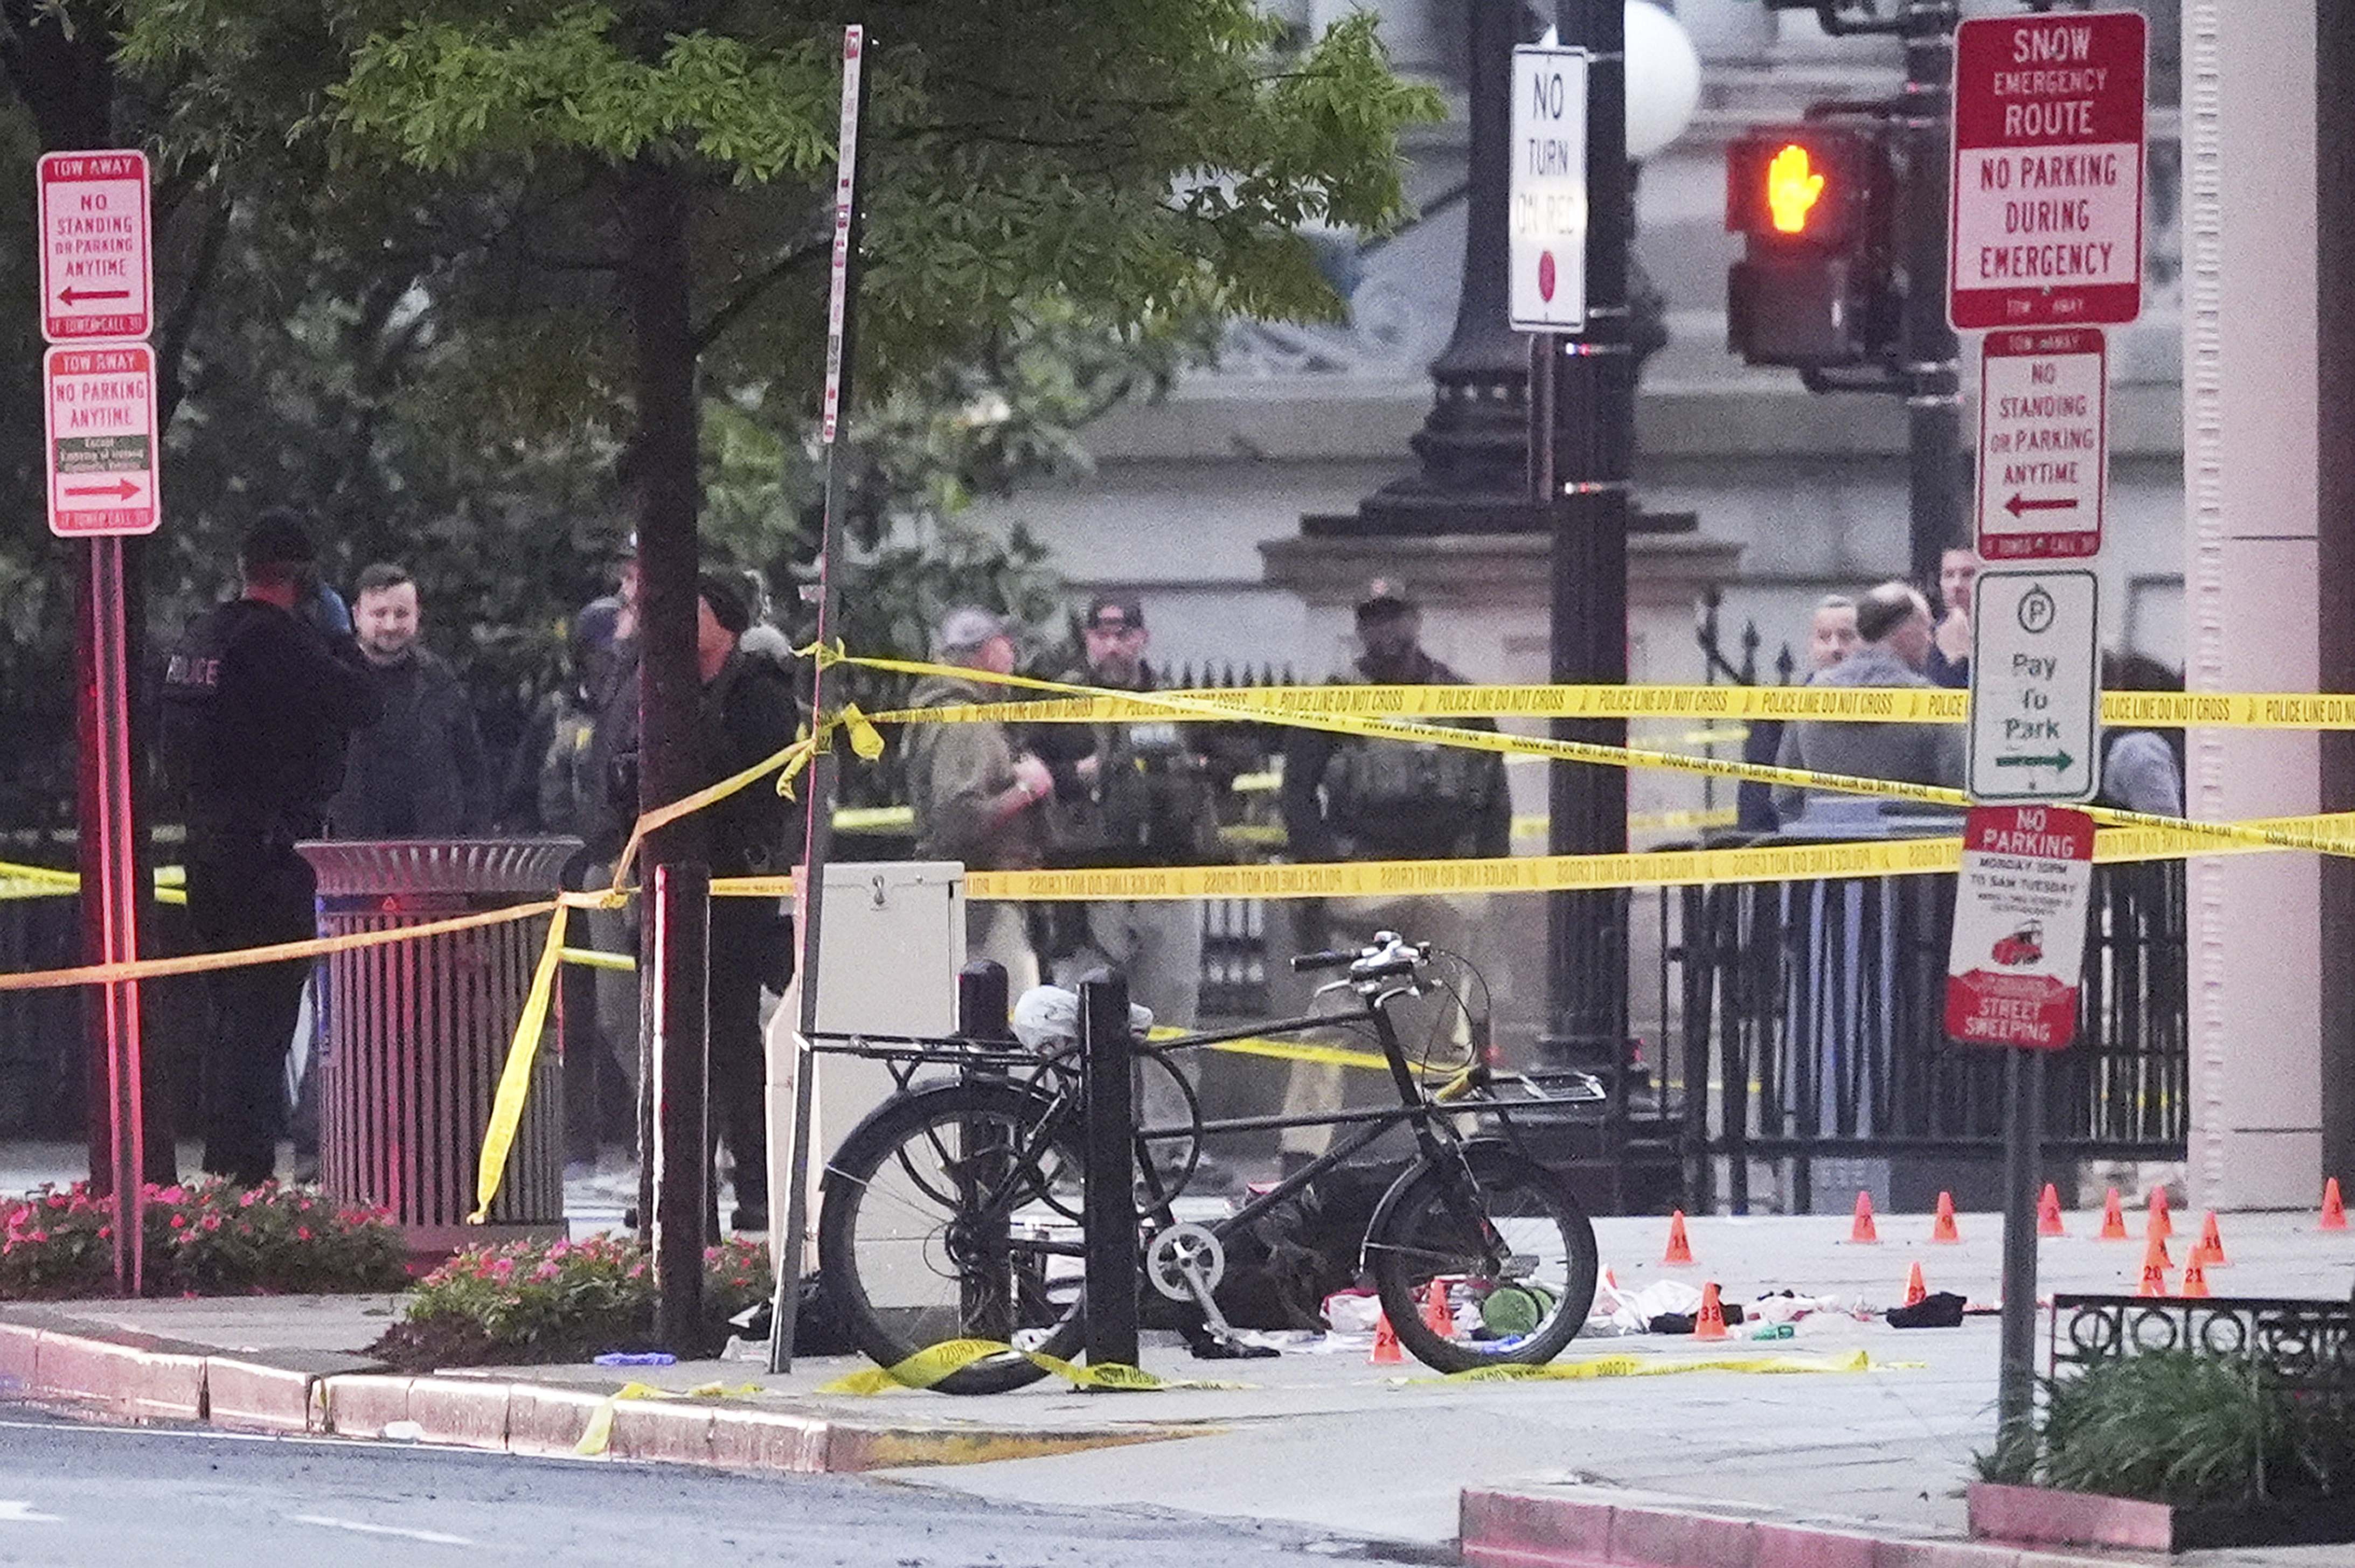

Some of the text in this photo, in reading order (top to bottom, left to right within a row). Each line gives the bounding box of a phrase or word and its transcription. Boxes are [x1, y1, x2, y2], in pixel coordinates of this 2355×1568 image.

[2013, 27, 2092, 63] SNOW
[1994, 68, 2108, 95] EMERGENCY
[1534, 73, 1562, 120] NO
[2005, 101, 2095, 137] ROUTE
[1529, 138, 1568, 175] TURN
[54, 160, 131, 176] TOW AWAY
[1981, 154, 2117, 190] NO PARKING
[81, 194, 107, 211] NO
[1517, 194, 1537, 234] ON
[2005, 199, 2089, 233] DURING
[58, 217, 133, 235] STANDING
[55, 238, 133, 254] OR PARKING
[66, 259, 126, 277] ANYTIME
[1981, 243, 2113, 278] EMERGENCY
[63, 354, 135, 372] TOW AWAY
[2031, 363, 2055, 384] NO
[57, 381, 144, 402] NO PARKING
[2000, 395, 2086, 417] STANDING
[71, 408, 132, 428] ANYTIME
[2016, 429, 2095, 451] PARKING
[2004, 462, 2078, 484] ANYTIME
[2030, 599, 2045, 623] P
[2012, 654, 2057, 680] Pay
[1281, 690, 1404, 711] POLICE LINE DO NOT CROSS
[1437, 689, 1565, 710] POLICE LINE DO NOT CROSS
[1599, 690, 1728, 711] POLICE LINE DO NOT CROSS
[1762, 692, 1894, 714] POLICE LINE DO NOT CROSS
[1928, 694, 1964, 716] POLICE
[2023, 689, 2047, 709] To
[2103, 698, 2229, 720] OLICE LINE DO NOT CROSS
[2266, 700, 2301, 722] POLICE
[2303, 700, 2325, 722] LINE
[2328, 700, 2342, 722] DO
[2006, 719, 2060, 739] Park
[2017, 809, 2046, 831] NO
[1983, 828, 2074, 859] PARKING
[1971, 874, 1985, 885] TO
[1978, 998, 2041, 1020] STREET
[1964, 1016, 2052, 1043] SWEEPING
[2185, 1267, 2203, 1283] 21
[1700, 1307, 1720, 1321] 33
